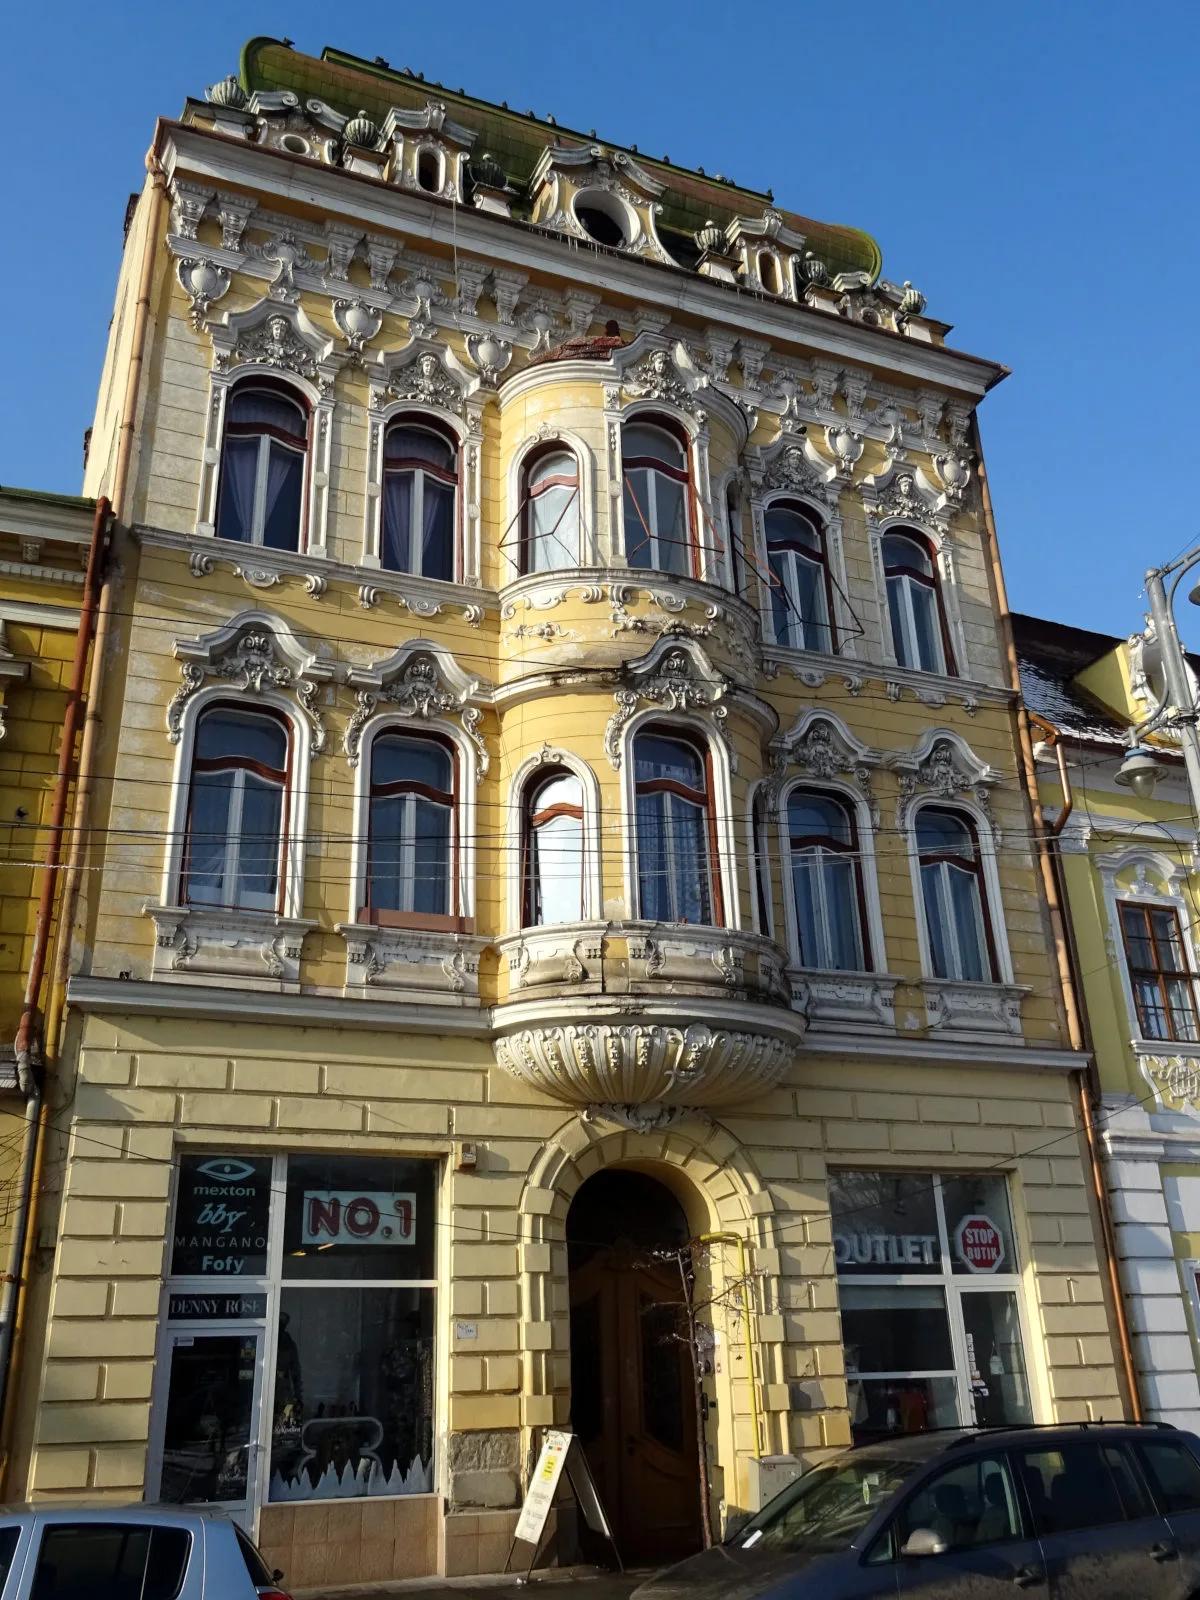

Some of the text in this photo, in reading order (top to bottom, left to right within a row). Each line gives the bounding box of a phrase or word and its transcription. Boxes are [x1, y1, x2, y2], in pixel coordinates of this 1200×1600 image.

[193, 1186, 256, 1197] mexton
[308, 1197, 412, 1238] NO.1
[174, 1237, 266, 1248] MANGANO
[965, 1228, 995, 1245] STOP
[967, 1247, 998, 1261] BUTIK
[201, 1255, 246, 1274] Fofy
[170, 1299, 262, 1314] DENNY ROSE
